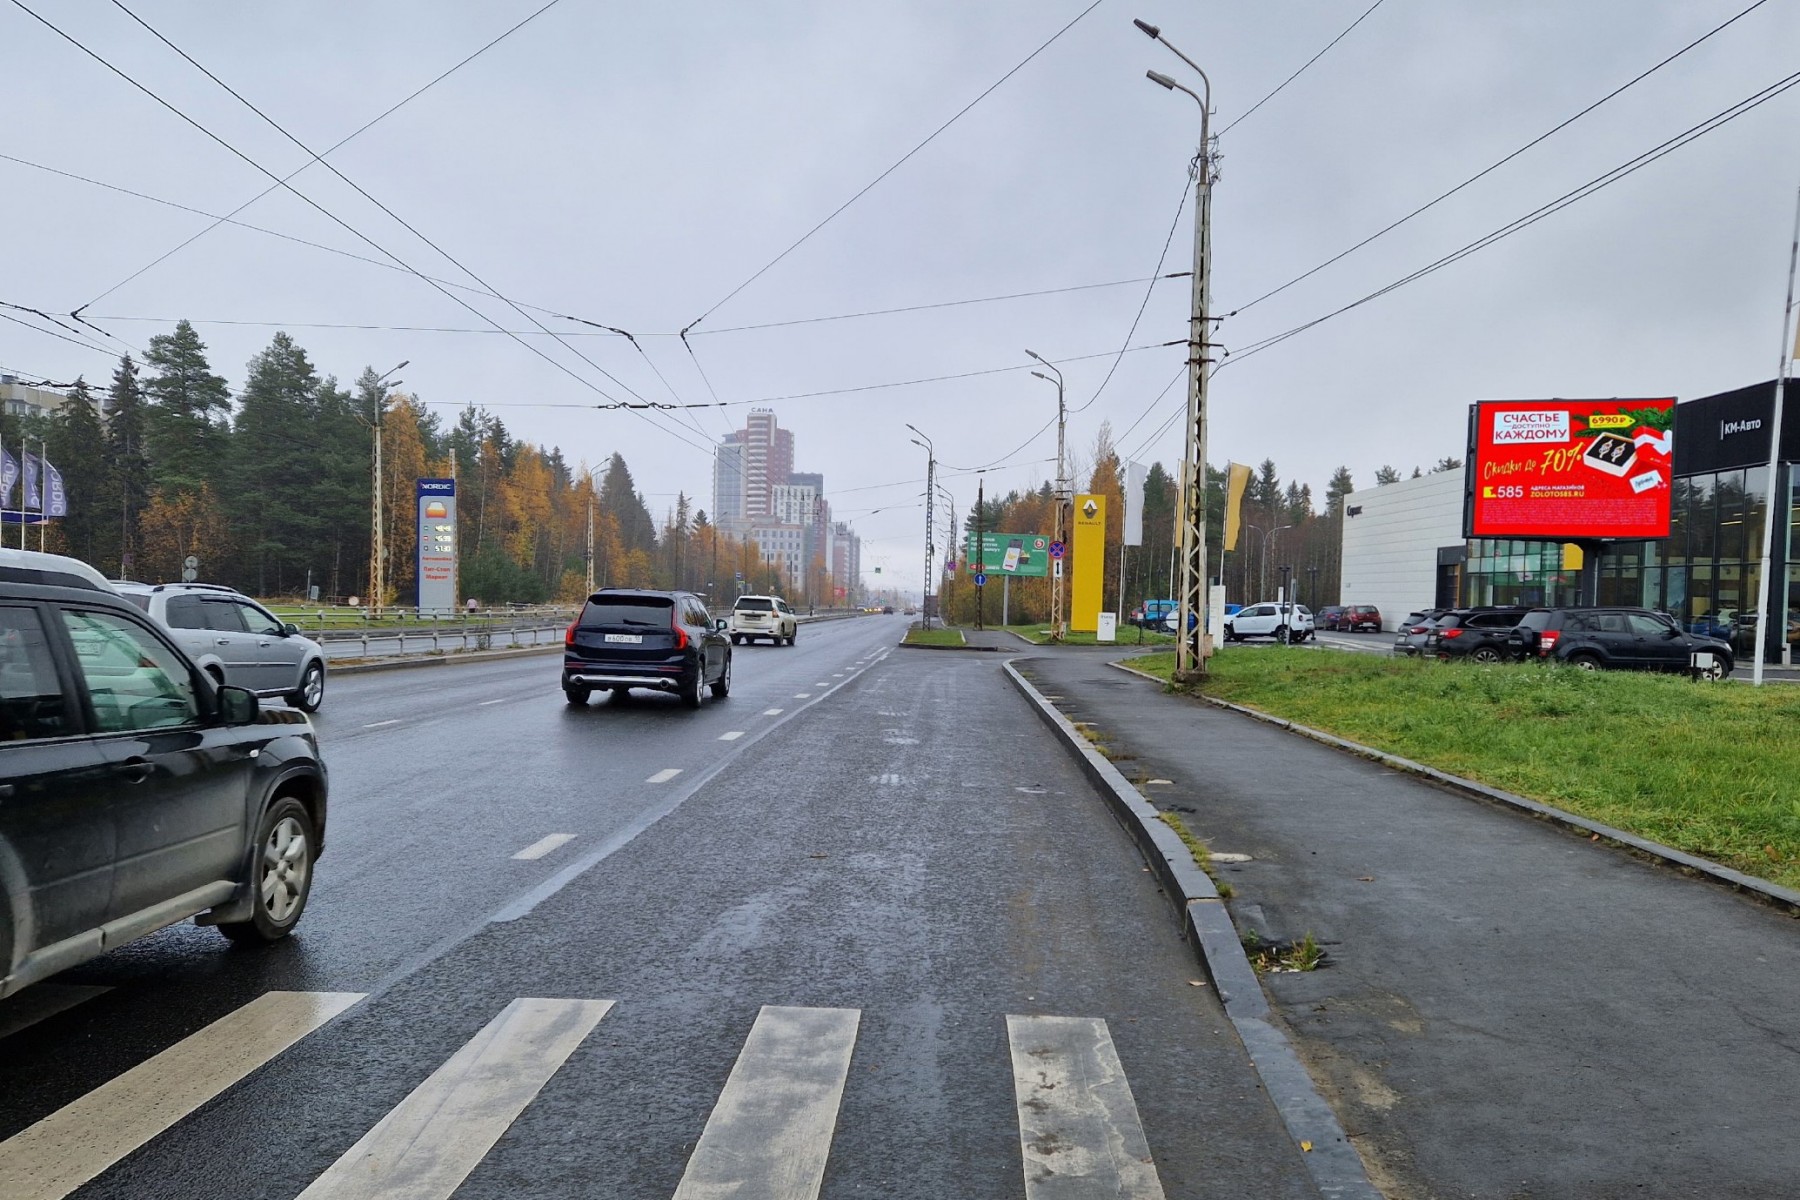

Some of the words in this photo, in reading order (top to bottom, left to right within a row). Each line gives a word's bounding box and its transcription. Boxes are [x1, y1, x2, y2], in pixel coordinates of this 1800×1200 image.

[1503, 413, 1560, 423] СЧАСТЬЕ
[1592, 416, 1618, 424] 6990
[1724, 419, 1761, 435] КМ-Авто
[1495, 429, 1567, 440] КАЖДОМУ
[1540, 442, 1585, 476] 70%
[1497, 485, 1524, 498] 585
